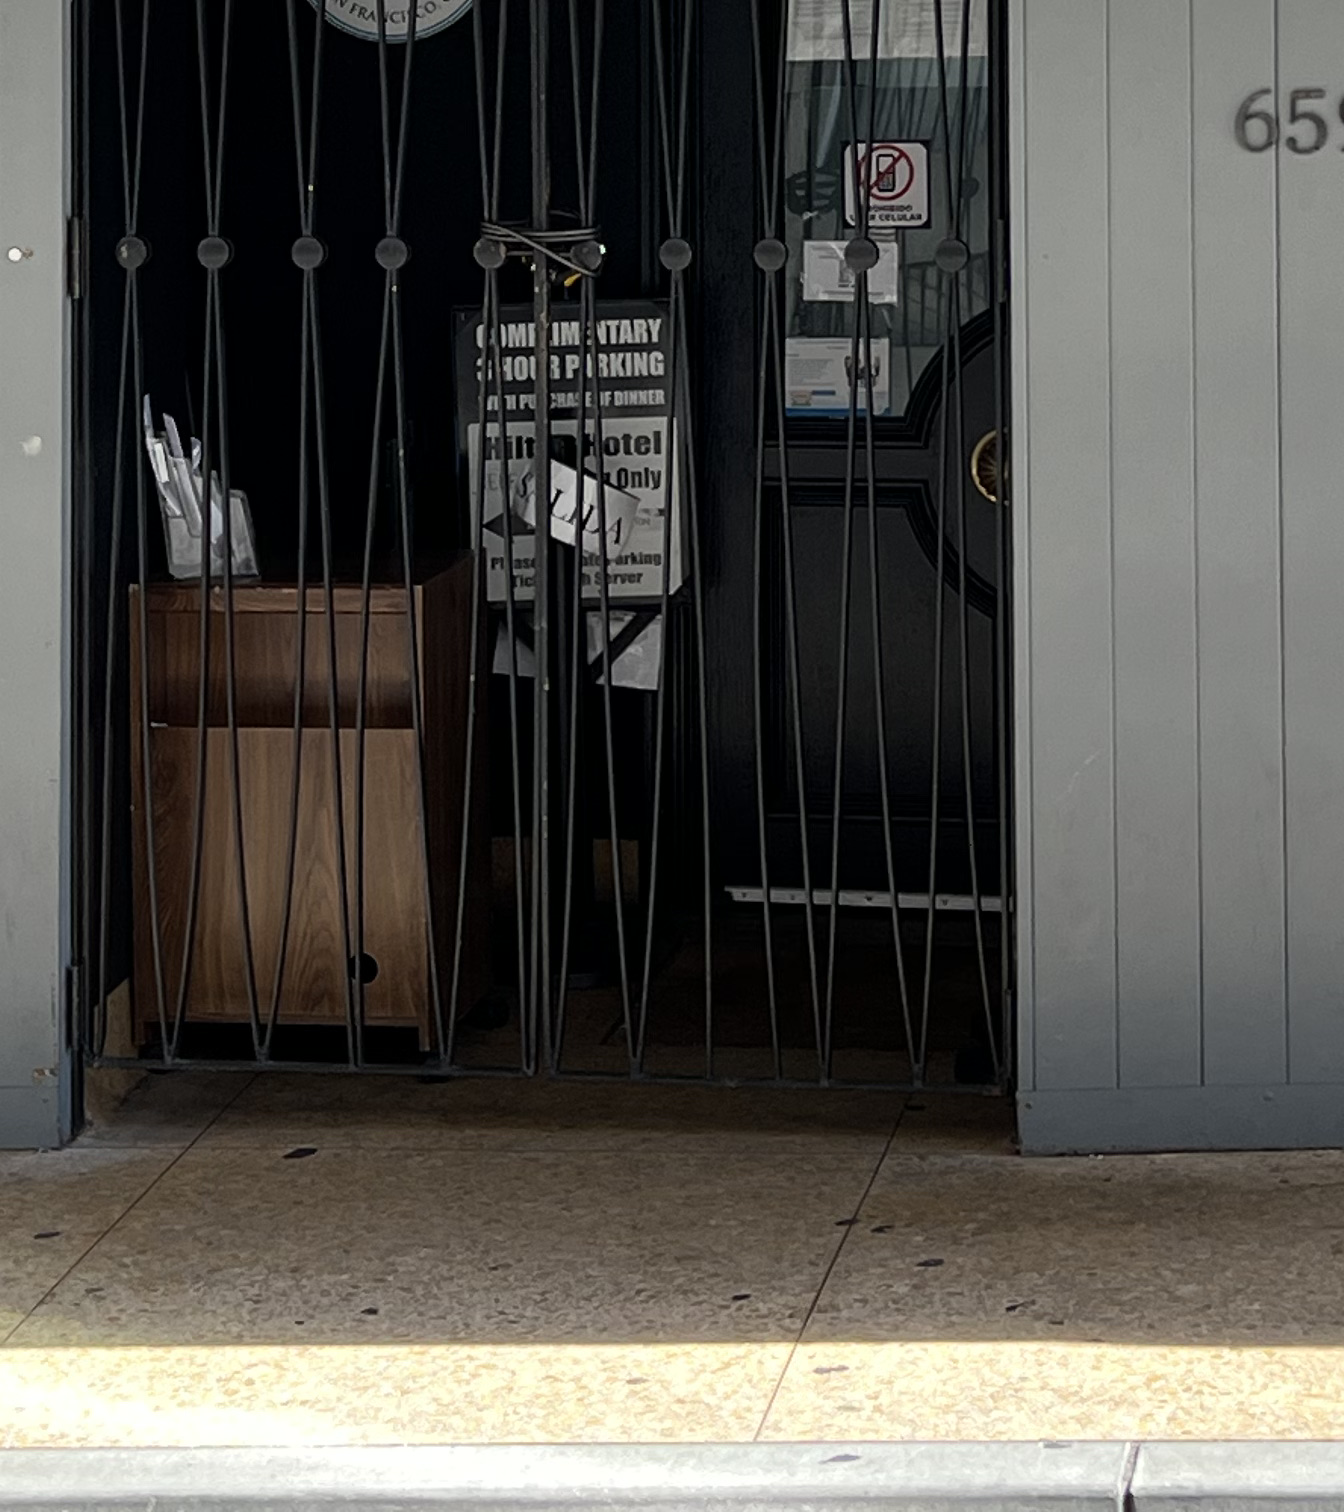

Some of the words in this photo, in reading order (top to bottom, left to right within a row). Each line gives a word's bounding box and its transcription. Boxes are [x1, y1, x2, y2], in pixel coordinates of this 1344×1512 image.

[519, 390, 593, 410] PUCHASE
[613, 388, 666, 407] DINNER
[616, 467, 662, 491] Only
[605, 551, 662, 567] arking
